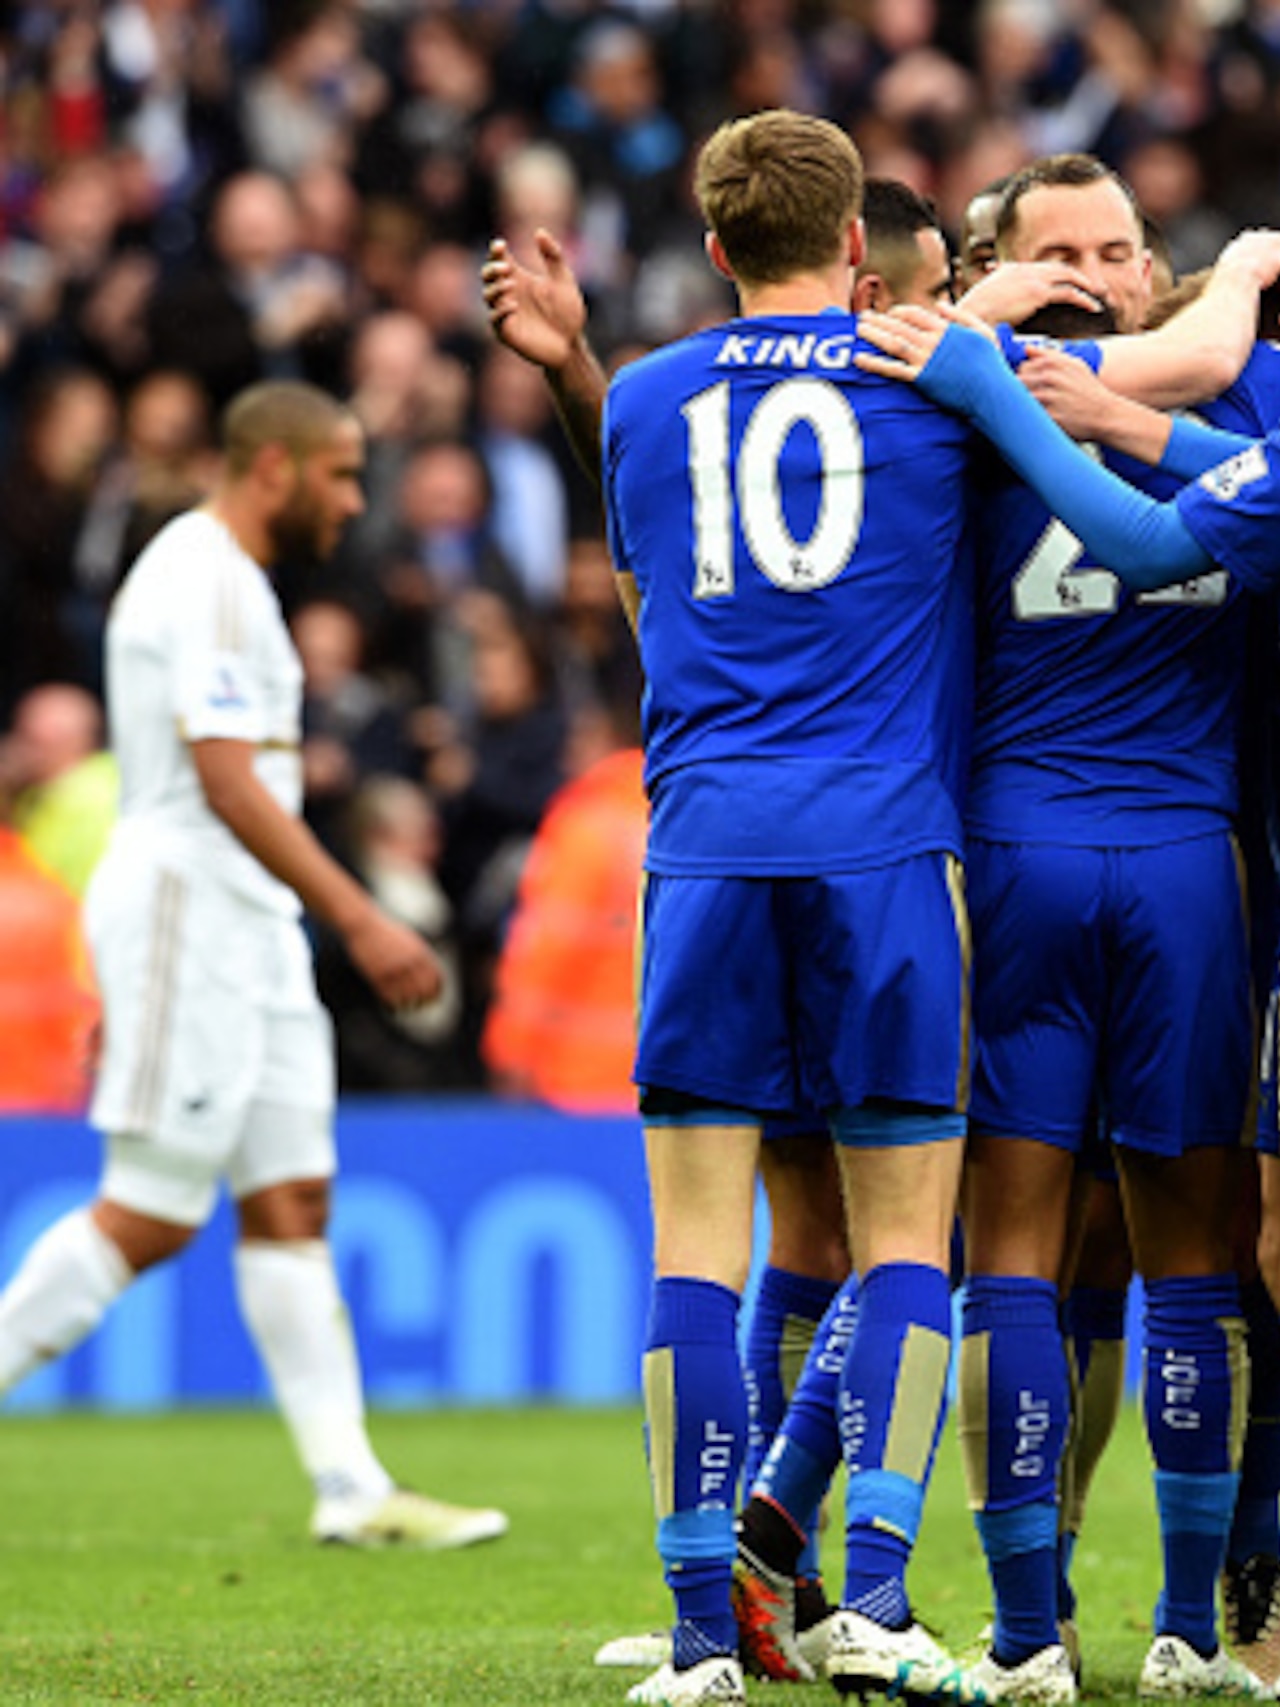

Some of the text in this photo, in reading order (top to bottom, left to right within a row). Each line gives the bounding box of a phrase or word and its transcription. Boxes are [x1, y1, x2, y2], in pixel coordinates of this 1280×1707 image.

[714, 333, 855, 369] KING
[682, 377, 864, 598] 10
[1162, 1348, 1201, 1429] LCFC
[1010, 1390, 1050, 1477] LCFC
